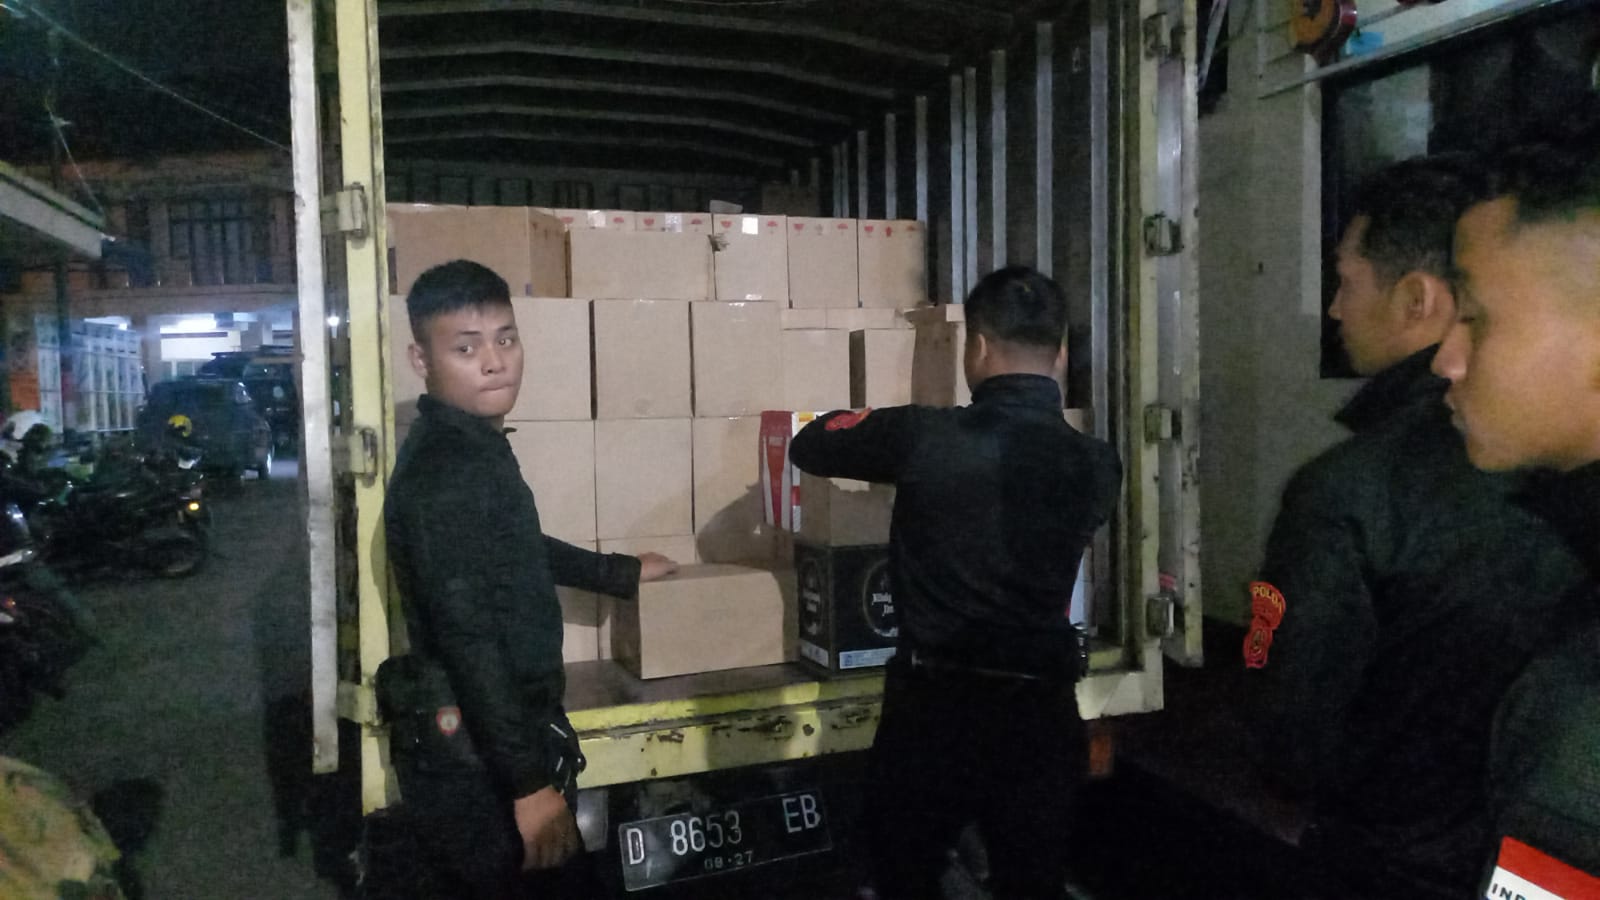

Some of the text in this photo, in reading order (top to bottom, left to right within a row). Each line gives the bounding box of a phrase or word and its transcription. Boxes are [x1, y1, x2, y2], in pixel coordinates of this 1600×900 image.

[626, 794, 822, 865] D 8653 EB
